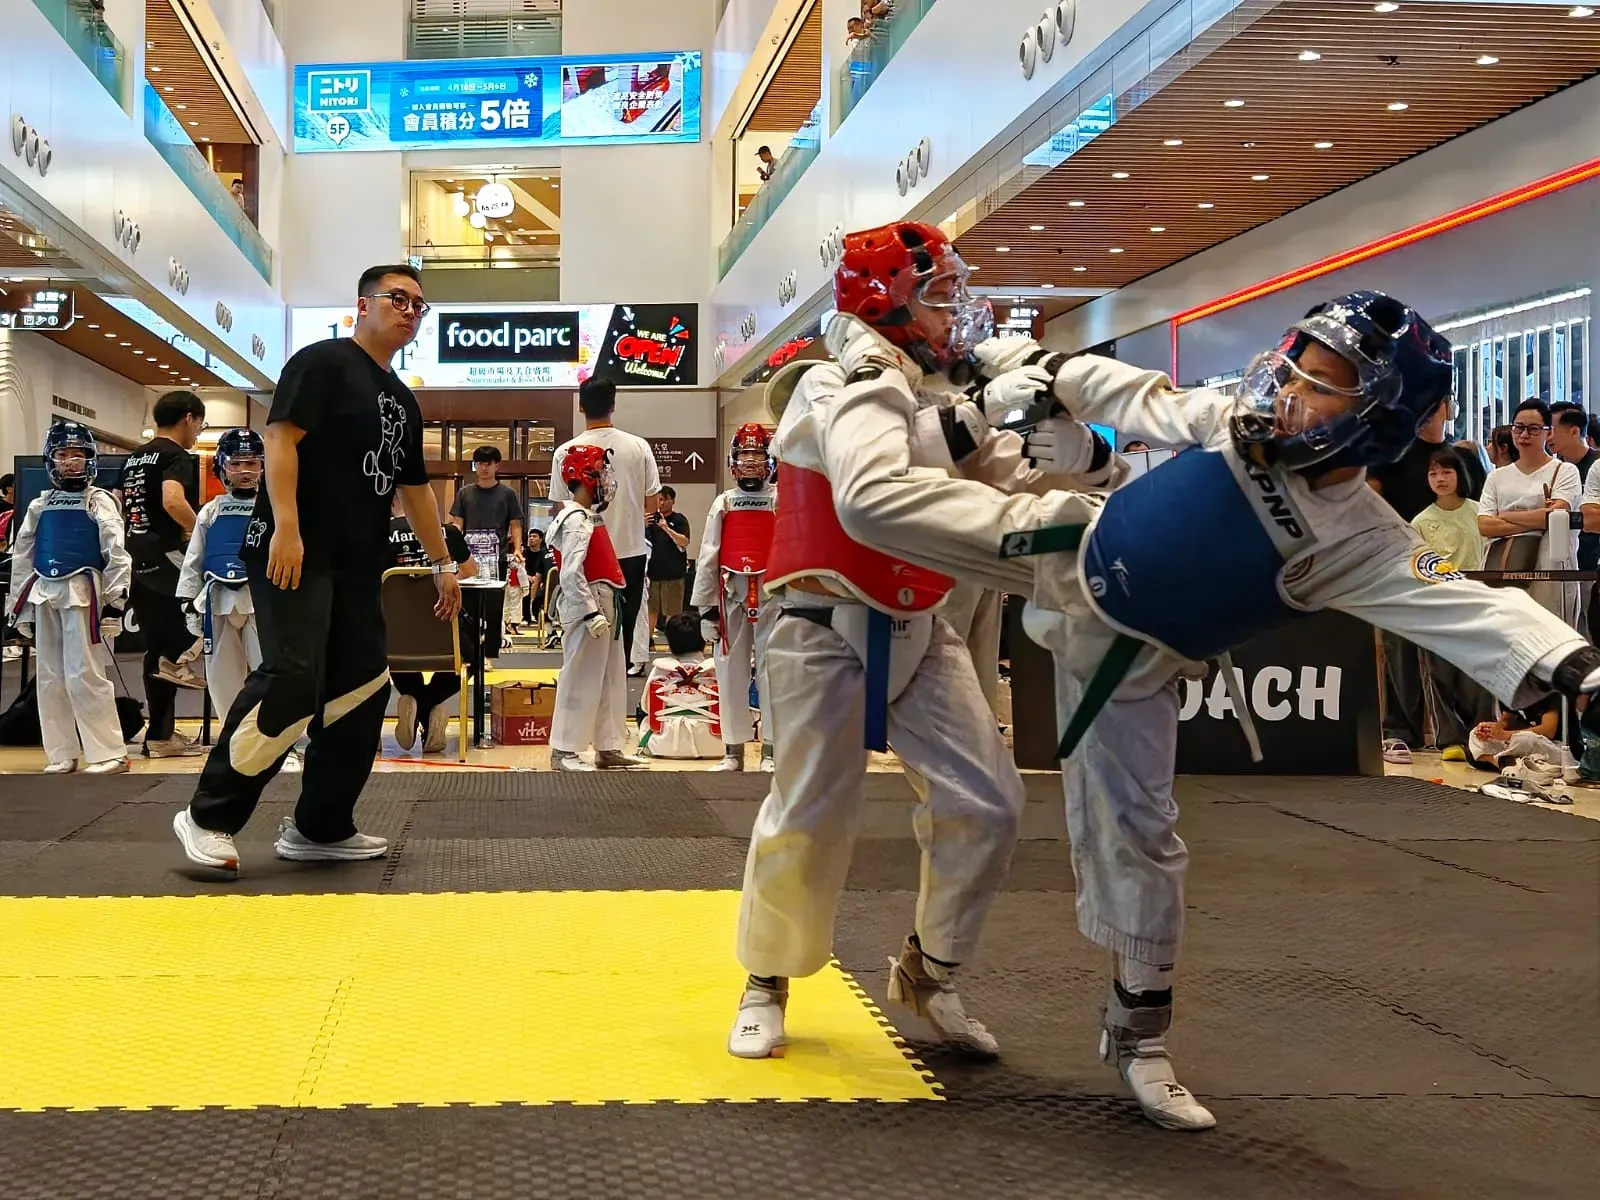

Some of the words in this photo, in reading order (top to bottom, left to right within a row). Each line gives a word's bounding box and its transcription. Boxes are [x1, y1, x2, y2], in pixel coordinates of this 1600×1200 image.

[320, 77, 359, 94] ニトリ
[320, 97, 359, 107] NITORI
[403, 111, 476, 132] 會員積分
[480, 98, 531, 131] 5倍
[330, 123, 346, 135] 5F
[447, 321, 510, 348] food
[514, 327, 571, 354] parc
[637, 329, 650, 339] WE
[650, 333, 667, 342] ARE
[617, 336, 682, 367] OPEN
[624, 361, 671, 380] Welcome!
[518, 721, 547, 737] vita
